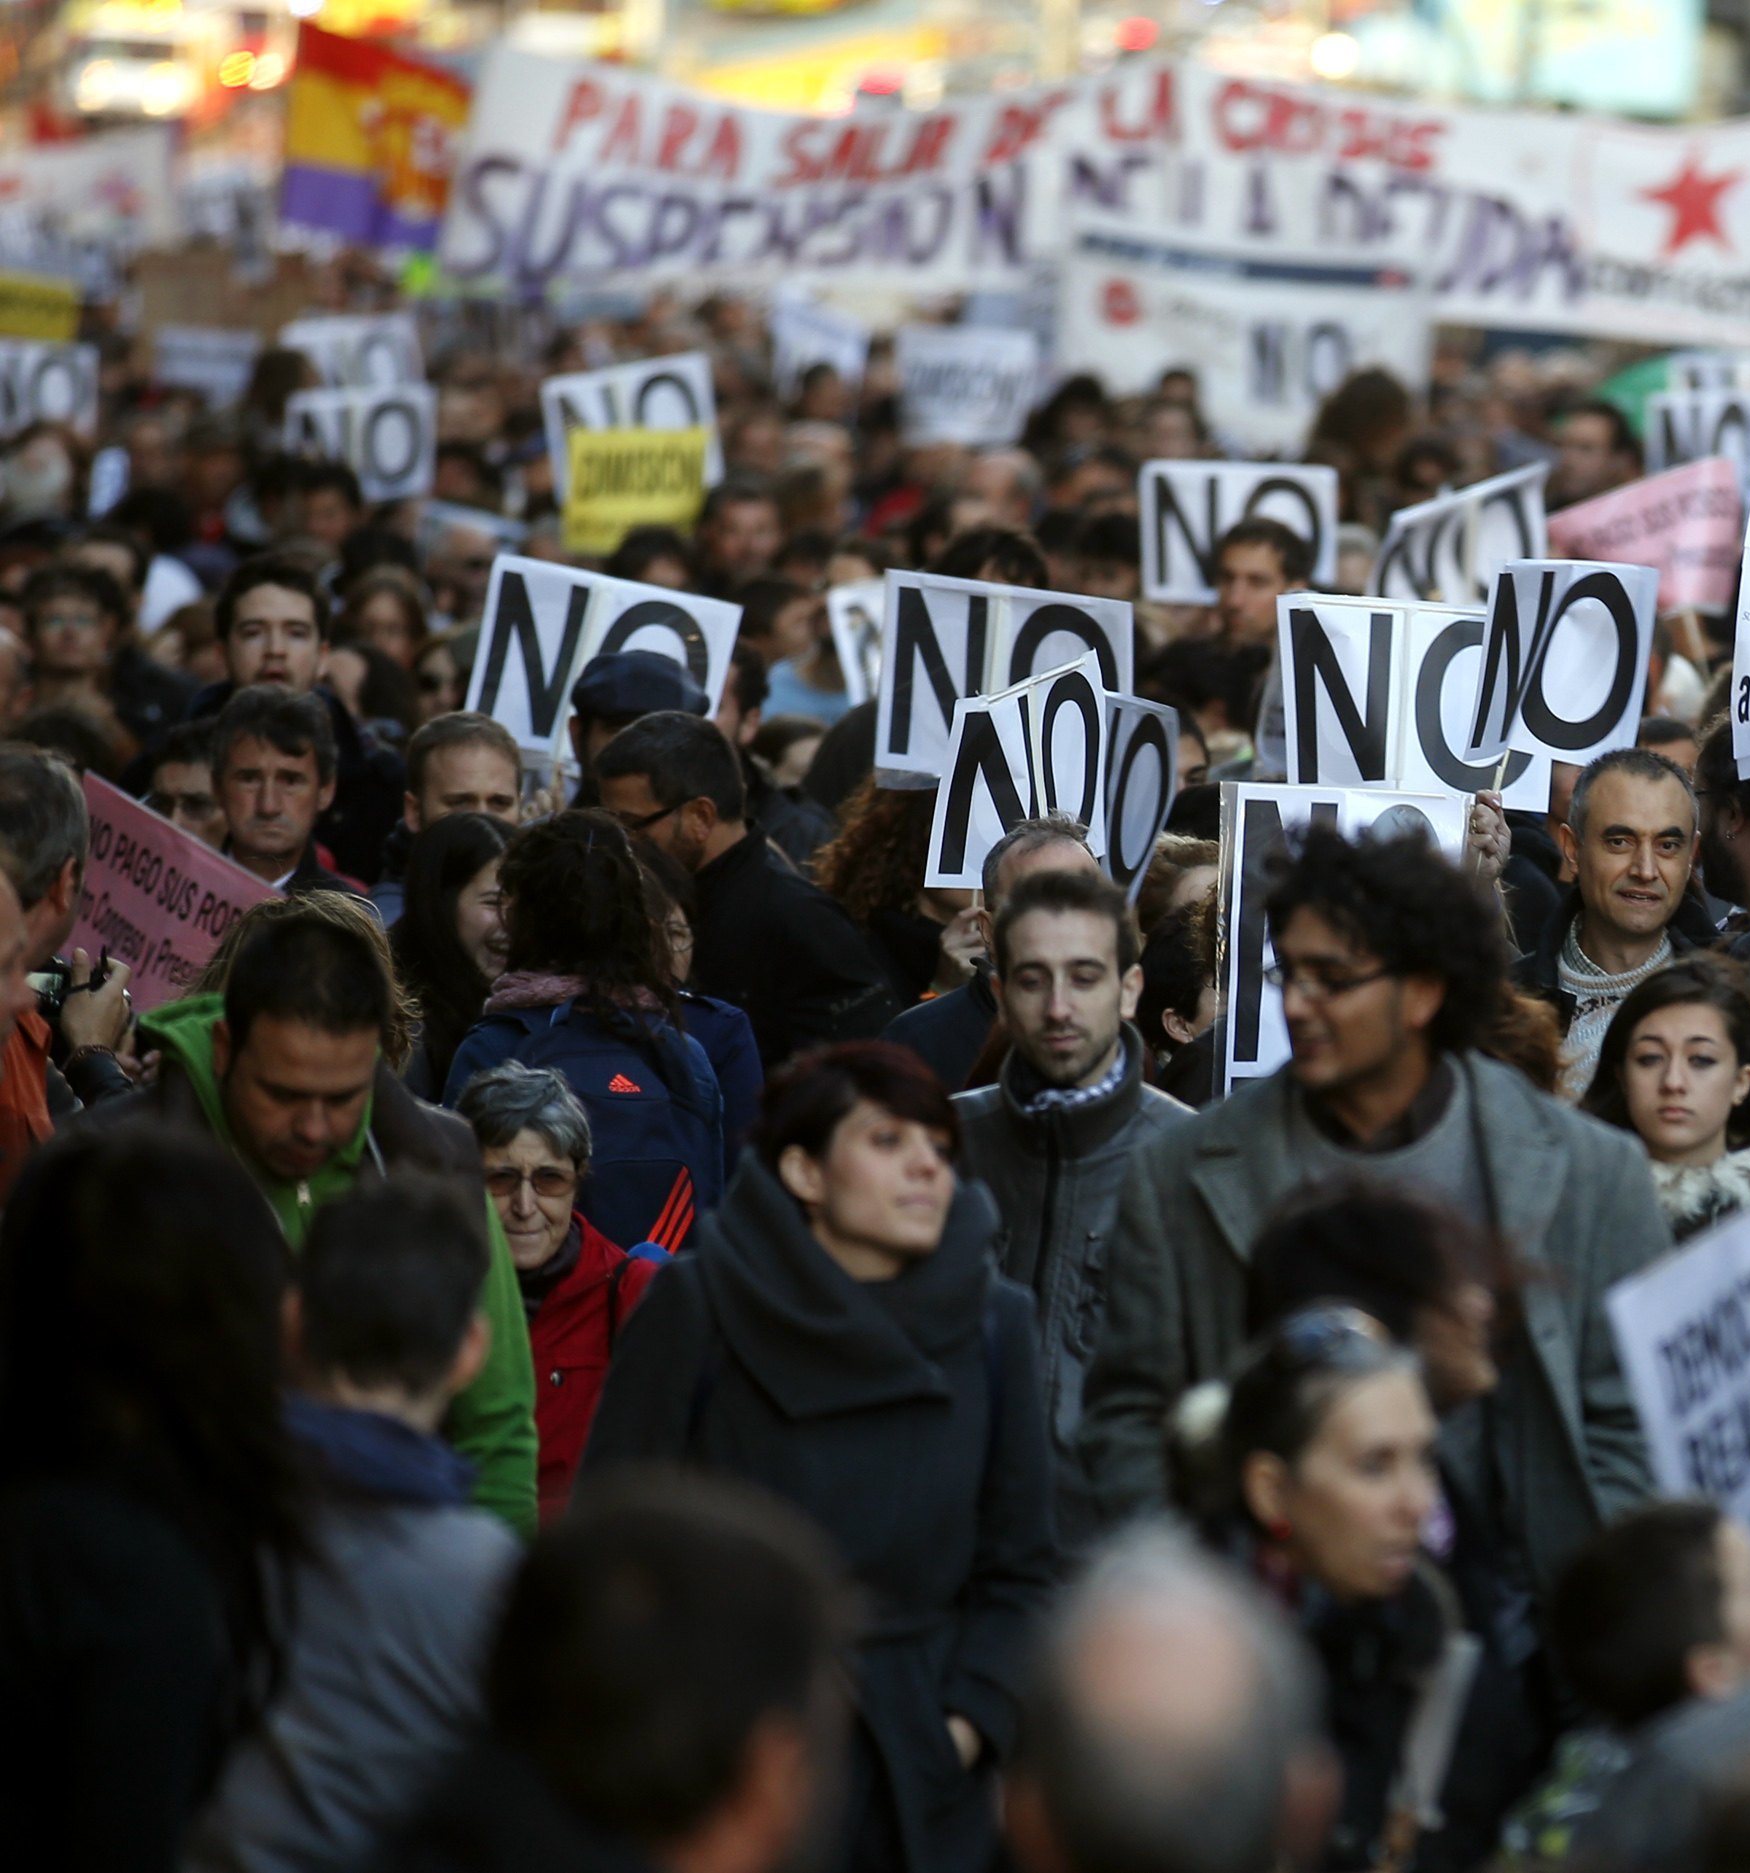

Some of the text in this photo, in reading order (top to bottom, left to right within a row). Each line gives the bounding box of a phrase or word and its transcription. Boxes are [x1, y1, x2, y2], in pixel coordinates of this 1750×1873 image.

[553, 75, 748, 181] PARA
[1155, 475, 1320, 588] NO
[481, 570, 710, 737] NO
[890, 586, 1120, 755] NO
[1290, 608, 1533, 793] NO
[1471, 571, 1638, 750] NO
[938, 670, 1101, 874] NO
[1104, 708, 1170, 870] O
[110, 832, 164, 895] PAGO
[157, 866, 199, 921] SUS
